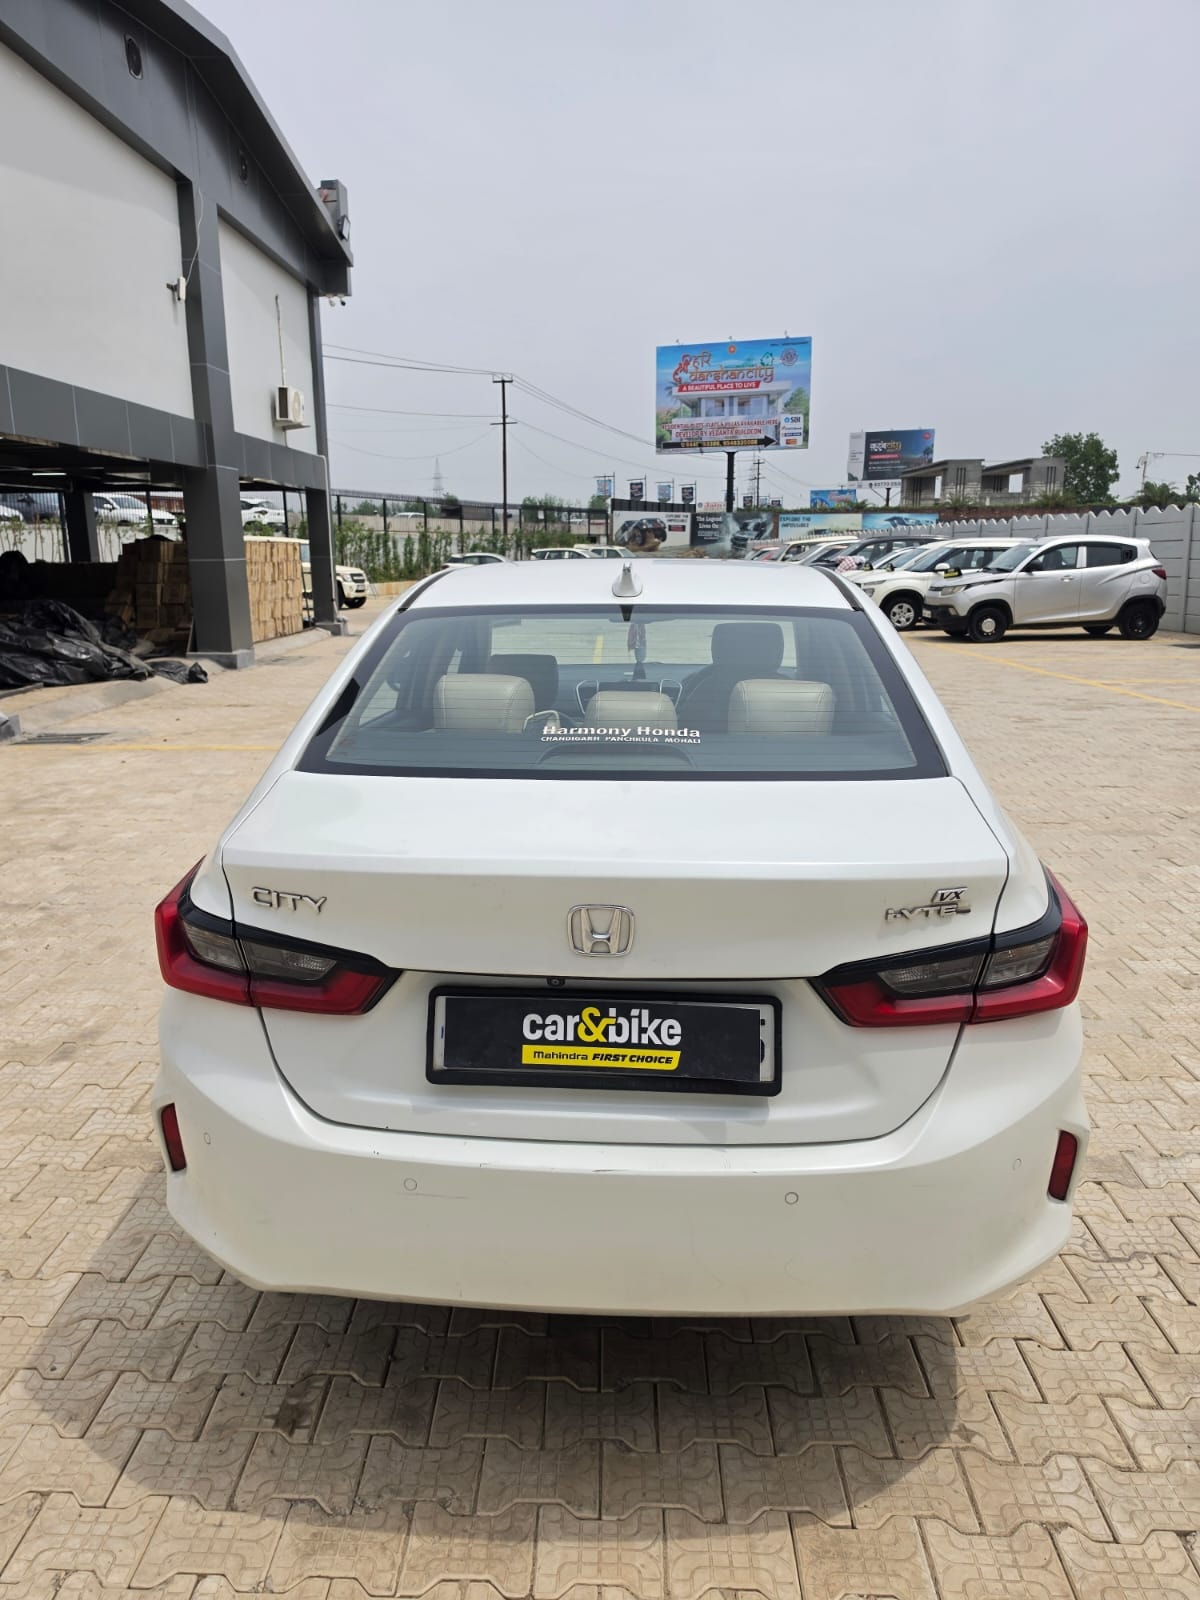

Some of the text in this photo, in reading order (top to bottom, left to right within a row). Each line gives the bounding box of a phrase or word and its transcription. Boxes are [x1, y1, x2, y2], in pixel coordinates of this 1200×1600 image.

[696, 514, 722, 523] The Legend
[542, 726, 701, 737] Harmony Honda
[252, 886, 328, 912] CITY
[522, 1006, 682, 1046] car&bike
[533, 1051, 673, 1064] Mahindra FIRST CHOICE
